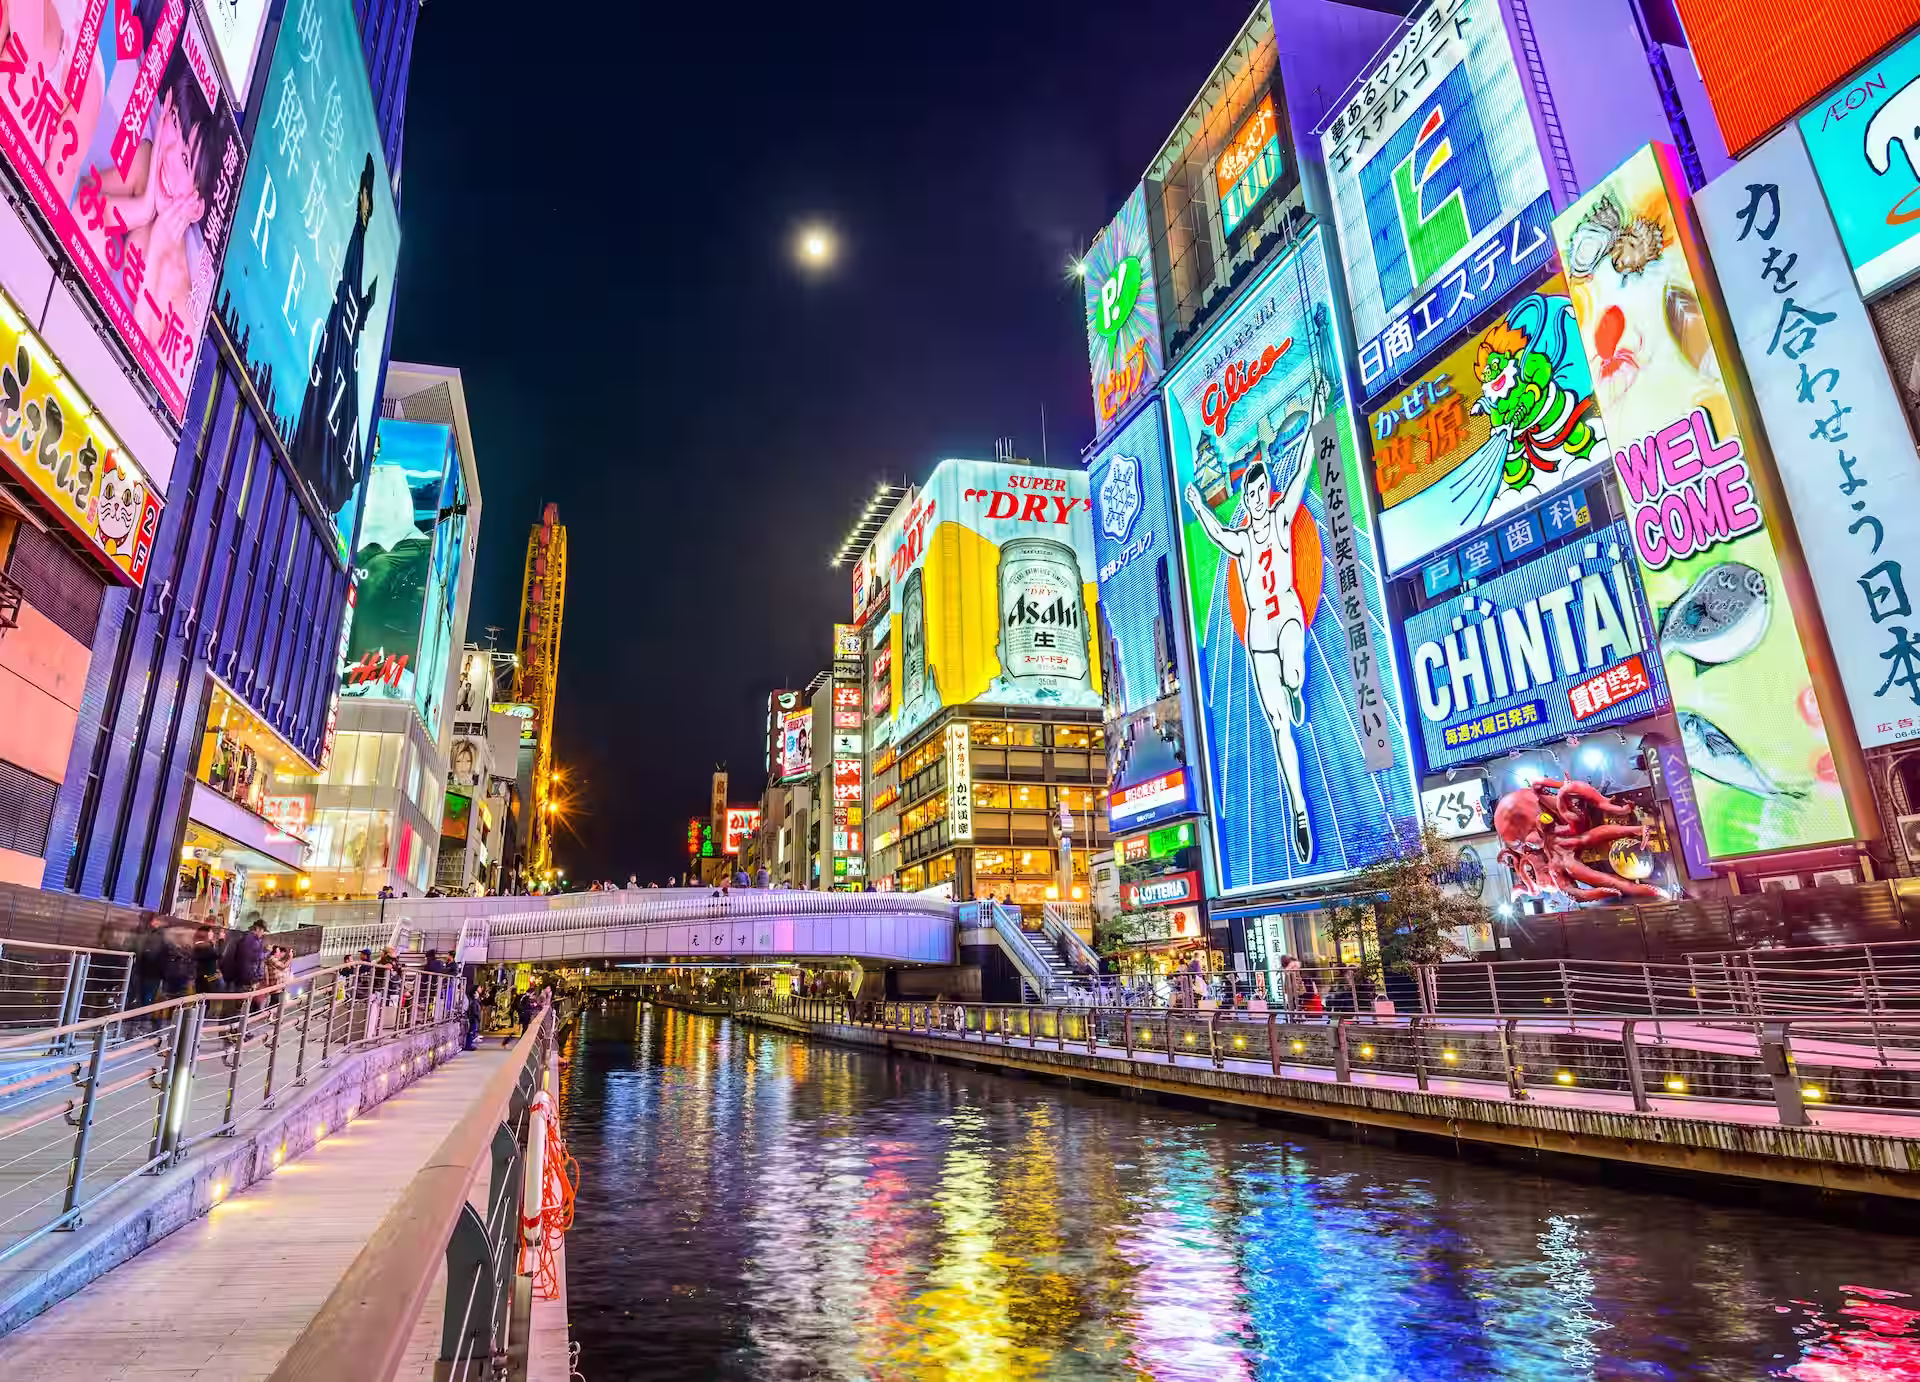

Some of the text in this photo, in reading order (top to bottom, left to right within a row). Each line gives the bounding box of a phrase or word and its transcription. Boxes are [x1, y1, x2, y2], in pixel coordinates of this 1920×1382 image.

[119, 10, 136, 52] VS
[185, 33, 217, 106] NMB48
[1336, 16, 1473, 173] エステムコート
[249, 164, 359, 480] REGZA
[1357, 219, 1549, 386] 日商エステム
[1200, 335, 1293, 438] Glico
[1373, 373, 1452, 441] かぜに
[1735, 182, 1920, 708] 力を合わせよう日本
[1007, 475, 1067, 493] SUPER
[132, 504, 156, 574] 2F
[1257, 545, 1281, 621] グリコ
[1320, 435, 1386, 750] みんなに笑顔を届けたい。
[1007, 593, 1079, 630] Asahi
[1024, 655, 1069, 665] スーパードライ
[1033, 631, 1057, 648] 生
[349, 652, 409, 689] H&M
[1610, 673, 1647, 701] ニュース
[1444, 703, 1539, 745] 毎週水曜日発売
[1647, 747, 1661, 785] 2F
[956, 782, 969, 835] かに道楽
[1435, 790, 1475, 830] くくる
[1140, 879, 1185, 901] LOTTERIA
